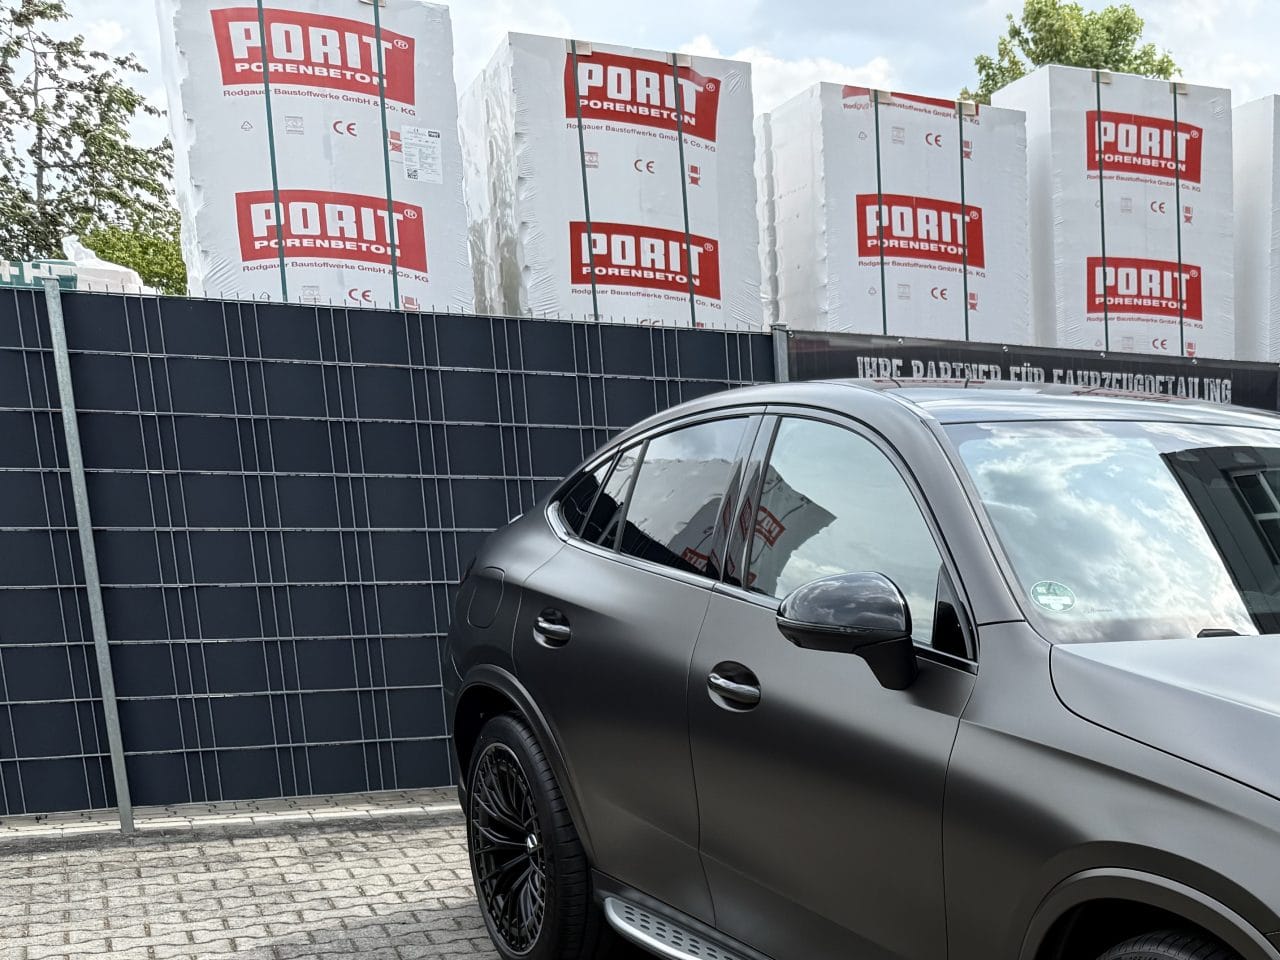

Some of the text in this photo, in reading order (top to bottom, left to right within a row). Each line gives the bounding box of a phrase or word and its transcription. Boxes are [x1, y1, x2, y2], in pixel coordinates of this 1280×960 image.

[235, 62, 387, 87] PORENBETON
[274, 88, 340, 100] Baustoffwerke
[341, 94, 370, 105] GmbH
[401, 107, 416, 117] KG
[579, 99, 696, 126] PORENBETON
[566, 122, 603, 131] Rogauer
[254, 238, 401, 257] PORENBETON
[243, 263, 289, 272] Rodgaur
[291, 261, 355, 270] Baustoffwerke
[357, 264, 386, 274] GmbH
[414, 274, 429, 283] KG
[582, 266, 700, 287] PORENBETON
[856, 356, 903, 378] IHRE
[911, 360, 1001, 381] PARTNER
[1009, 362, 1045, 383] FÜR
